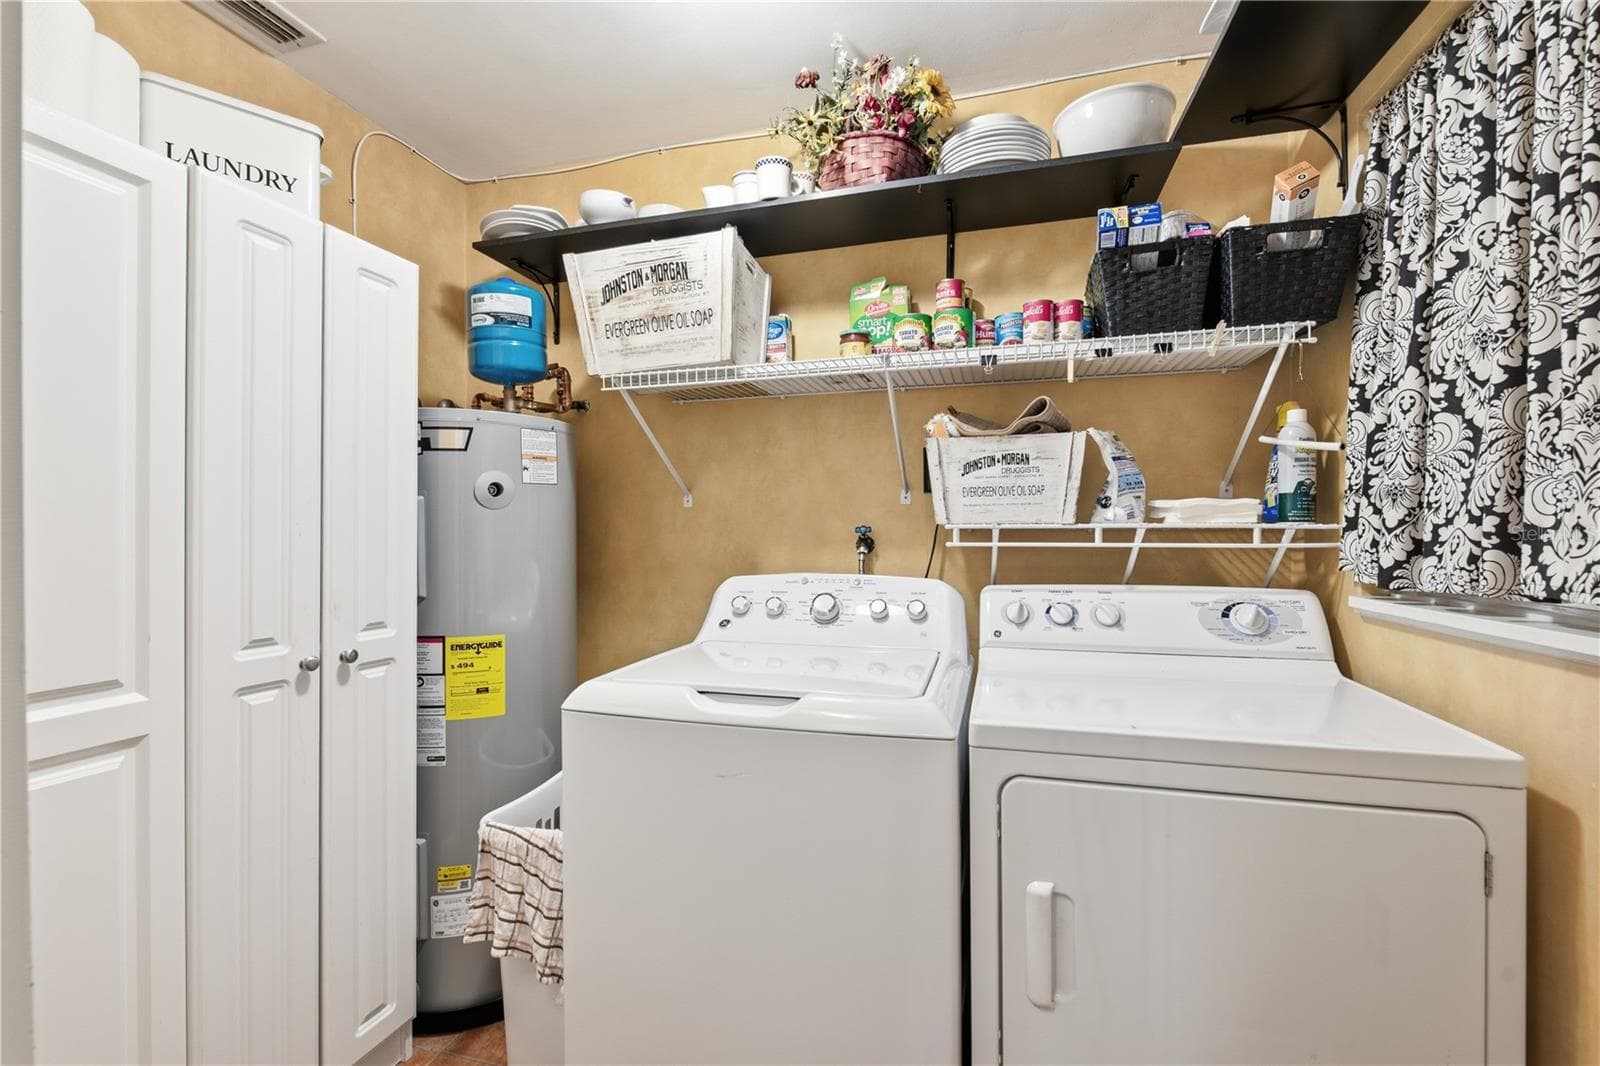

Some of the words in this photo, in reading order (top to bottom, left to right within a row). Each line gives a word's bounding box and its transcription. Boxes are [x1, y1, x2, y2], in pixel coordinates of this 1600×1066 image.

[164, 141, 298, 194] LAUNDRY
[600, 268, 644, 306] JOHNSTON
[650, 261, 689, 284] MORGAN
[652, 280, 704, 297] DRUGGISTS
[604, 318, 650, 340] EVERGREEN
[651, 314, 675, 333] OLIVE
[676, 311, 690, 329] OIL
[690, 308, 714, 327] SOAP
[857, 317, 887, 328] smart
[863, 322, 890, 339] op!
[961, 455, 996, 477] JOHNSTON
[1001, 453, 1030, 466] MORGAN
[1001, 466, 1040, 474] DRUGGISTS
[962, 485, 997, 498] EVERGREEN
[998, 485, 1016, 497] OLIVE
[1016, 485, 1027, 496] OIL
[1027, 484, 1046, 496] SOAP
